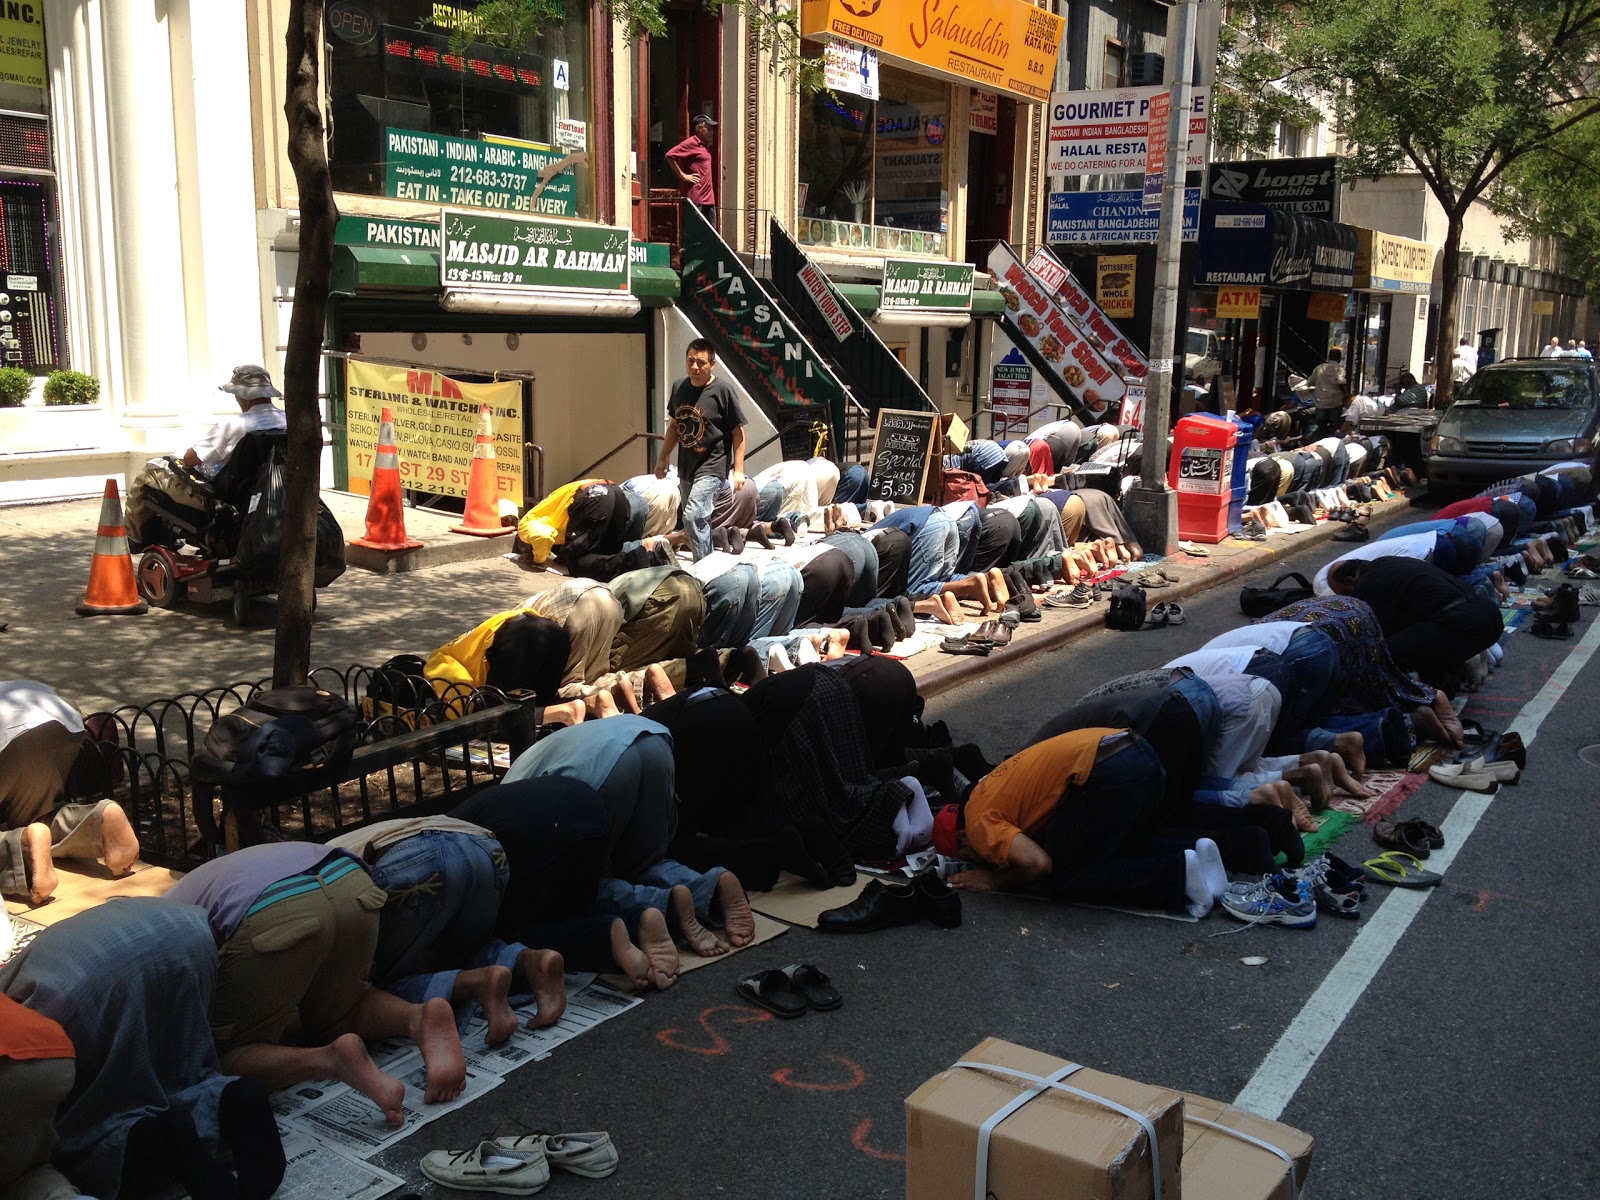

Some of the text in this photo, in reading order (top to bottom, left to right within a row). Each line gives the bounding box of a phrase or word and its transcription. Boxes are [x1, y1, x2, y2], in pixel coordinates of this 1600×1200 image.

[331, 11, 373, 35] OPEN
[833, 20, 882, 45] FREE DELIVERY
[7, 37, 41, 49] JEWELRY
[827, 35, 855, 55] LUNCH
[1024, 34, 1057, 56] KATA KUT
[556, 64, 566, 83] A
[947, 57, 1003, 84] RESTAURANT
[1054, 100, 1134, 121] GOURMET
[1051, 124, 1148, 138] PAKISTANI INDIAN BANGLADESHI
[388, 133, 439, 157] PAKISTANI
[446, 141, 478, 163] INDIAN
[484, 148, 516, 168] ARABIC
[1060, 144, 1101, 157] HALAL
[1051, 161, 1062, 171] WE
[1064, 161, 1076, 170] DO
[1078, 159, 1117, 170] CATERING
[1119, 158, 1135, 168] FOR
[450, 166, 528, 191] 212-683-3737
[1253, 168, 1331, 188] boost
[396, 181, 423, 200] EAT
[425, 185, 440, 202] IN
[450, 187, 482, 207] TAKE
[485, 191, 511, 209] OUT
[1265, 185, 1315, 197] mobile
[1301, 201, 1326, 211] GSM
[1052, 218, 1159, 230] PAKISTANI BANGLADESHI
[1050, 231, 1131, 241] ARBIC & AFRICAN
[446, 240, 626, 273] MASJID AR RAHMAN
[1381, 239, 1427, 270] SAFENET COMPUTER
[1040, 264, 1067, 287] ATM
[1099, 263, 1134, 272] ROTISSERIE
[502, 271, 514, 284] 29
[885, 278, 971, 295] MASJID AR RAHMAN
[1206, 272, 1266, 283] RESTAURANT
[801, 266, 852, 336] WATCH YOUR STEP
[1103, 290, 1129, 298] WHOLE
[1219, 291, 1259, 305] ATM
[1098, 299, 1133, 309] CHICKEN
[1004, 262, 1049, 317] Watch
[1044, 307, 1078, 347] Your
[1072, 340, 1113, 386] Step!
[1086, 308, 1118, 345] Your
[349, 386, 409, 405] STERLING
[411, 397, 422, 406] &
[495, 407, 521, 419] INC.
[348, 410, 380, 423] STERLIN
[397, 405, 474, 423] WHOLESALE/RETAIL
[349, 438, 373, 450] WATCH
[407, 449, 431, 460] WATCH
[432, 451, 453, 464] BAND
[454, 456, 468, 466] AND
[496, 462, 521, 474] REPAIR
[875, 450, 925, 469] Special
[356, 452, 372, 468] 17
[426, 466, 445, 481] 29
[450, 469, 517, 492] STET
[875, 468, 915, 482] Lunch
[428, 484, 456, 495] 213
